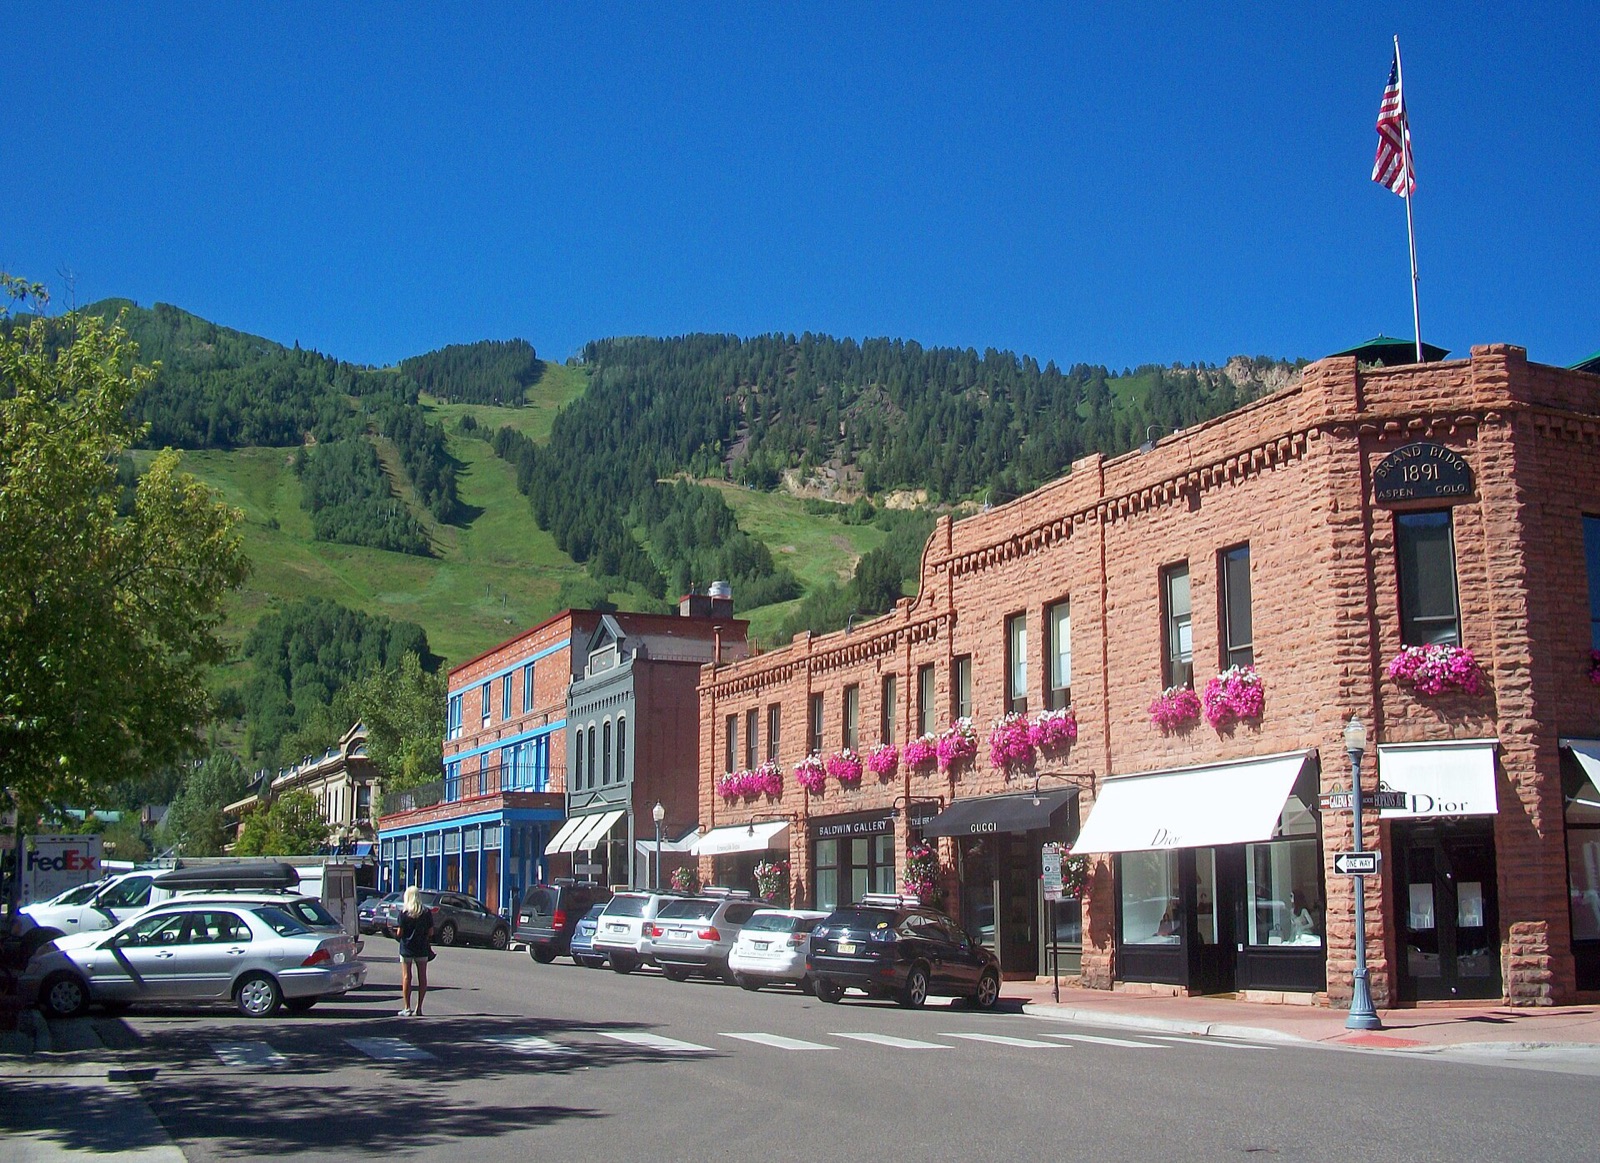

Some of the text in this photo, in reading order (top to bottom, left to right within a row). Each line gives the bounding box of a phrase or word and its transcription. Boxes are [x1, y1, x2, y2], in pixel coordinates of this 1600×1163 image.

[1376, 445, 1422, 478] BRAND
[1402, 463, 1439, 482] 1891
[1378, 488, 1414, 498] ASPEN
[1410, 793, 1468, 813] Dior
[819, 820, 887, 836] BALDWIN GALLERY
[970, 822, 997, 833] GUCCI
[1151, 828, 1182, 846] Dior
[27, 849, 96, 871] FedEx
[1346, 859, 1372, 868] ONE WAY
